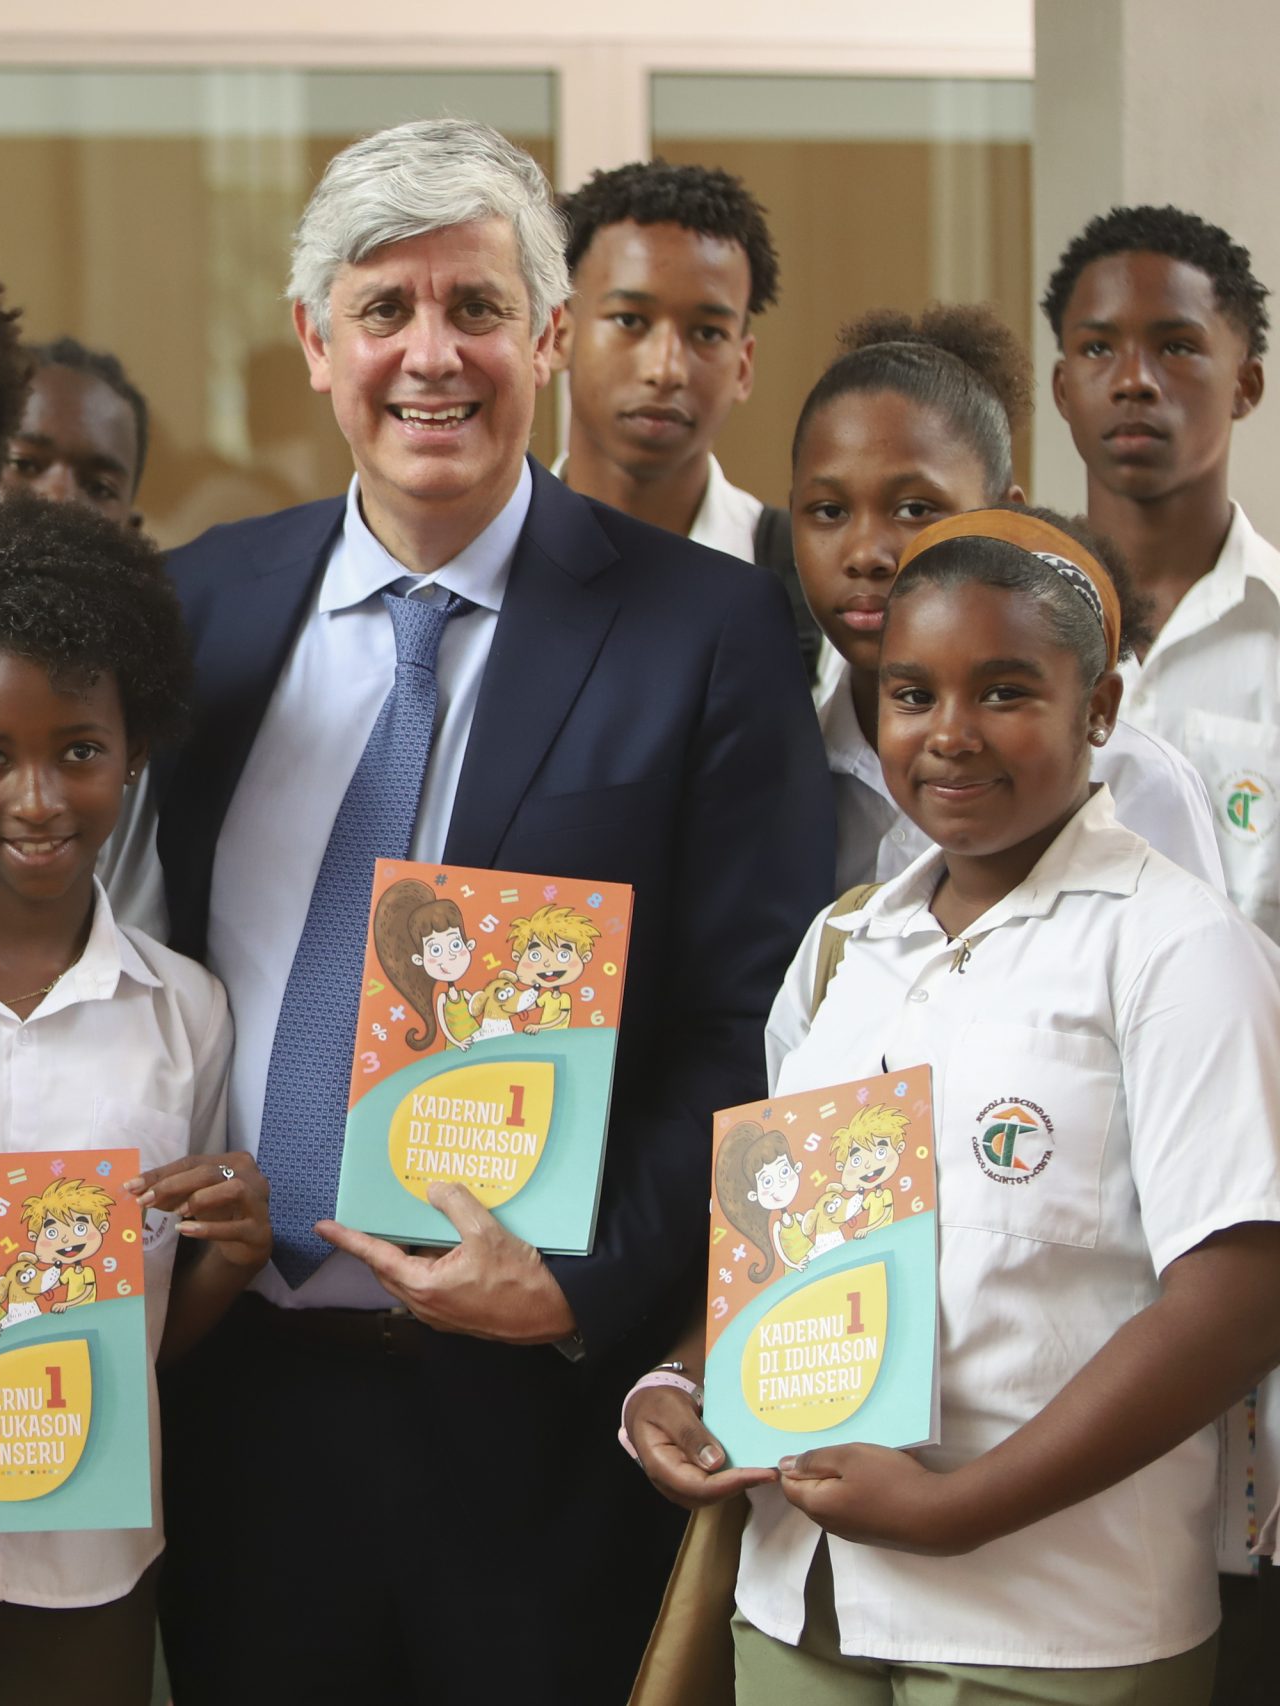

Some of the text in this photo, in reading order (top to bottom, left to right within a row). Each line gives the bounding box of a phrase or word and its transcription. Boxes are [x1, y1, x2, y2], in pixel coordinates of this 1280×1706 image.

[461, 885, 474, 897] 1
[587, 893, 604, 908] 8
[479, 914, 499, 932] 5
[483, 953, 501, 969] 1
[603, 962, 617, 976] 0
[581, 987, 595, 1001] 9
[591, 1010, 605, 1025] 6
[360, 1052, 381, 1073] 3
[895, 1082, 908, 1097] 8
[412, 1085, 525, 1127] KADERNU 1
[976, 1097, 1006, 1124] ESCOLA
[784, 1112, 797, 1124] 1
[409, 1120, 537, 1157] DI IDUKASON
[804, 1133, 821, 1151] 5
[916, 1146, 928, 1159] 0
[96, 1161, 112, 1176] 8
[406, 1147, 518, 1181] FINANSERU
[810, 1170, 827, 1186] 1
[900, 1176, 912, 1192] 9
[911, 1196, 924, 1212] 6
[122, 1229, 136, 1242] 0
[0, 1237, 19, 1254] 1
[103, 1257, 117, 1272] 9
[117, 1280, 132, 1295] 6
[711, 1296, 729, 1320] 3
[760, 1291, 865, 1348] KADERNU 1
[758, 1336, 878, 1375] DI IDUKASON
[45, 1366, 66, 1408] 1
[758, 1366, 862, 1403] FINANSERU
